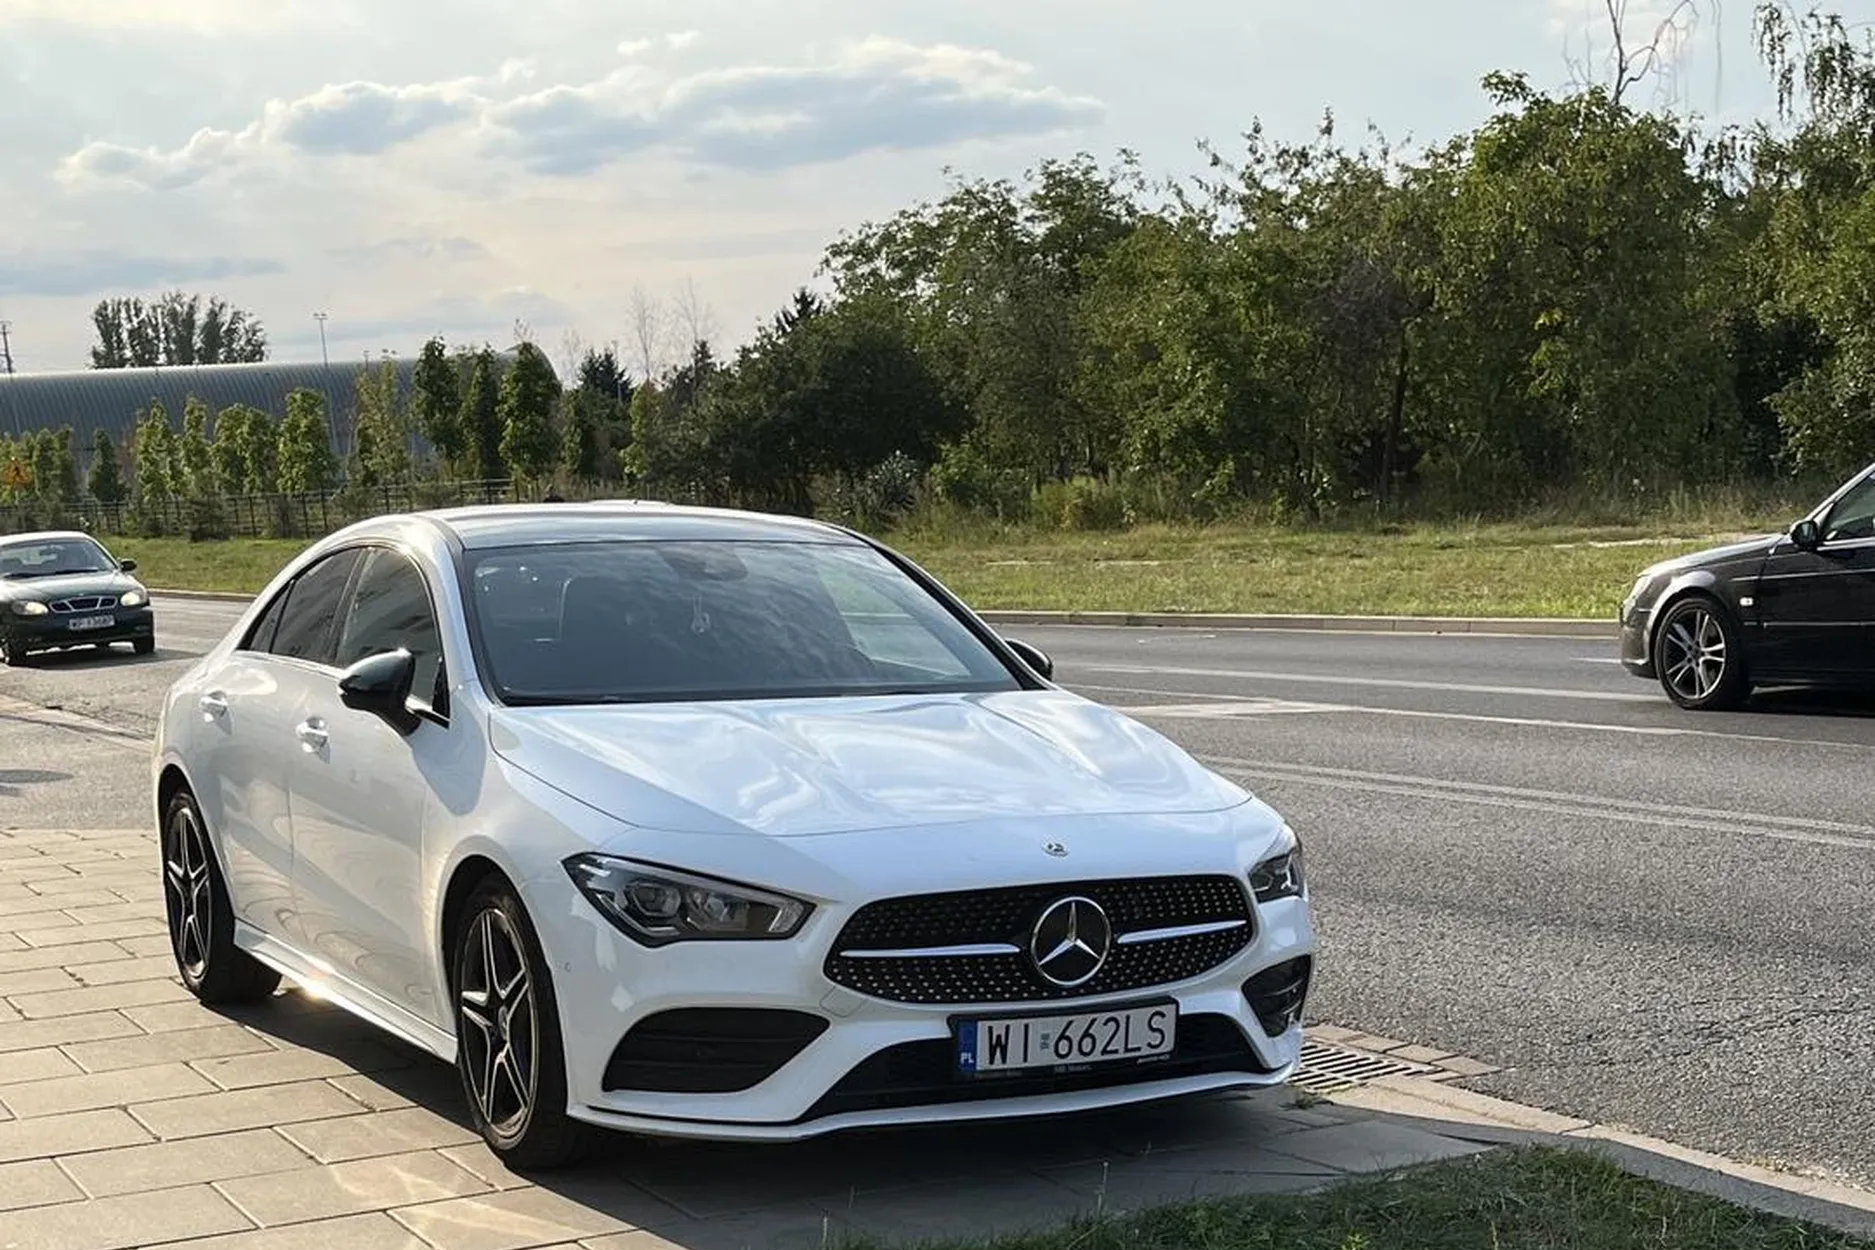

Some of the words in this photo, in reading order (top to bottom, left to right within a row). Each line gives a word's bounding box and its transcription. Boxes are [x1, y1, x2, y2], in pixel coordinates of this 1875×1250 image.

[987, 1023, 1030, 1066] WI
[1053, 1011, 1167, 1060] 662LS
[960, 1053, 975, 1065] PL
